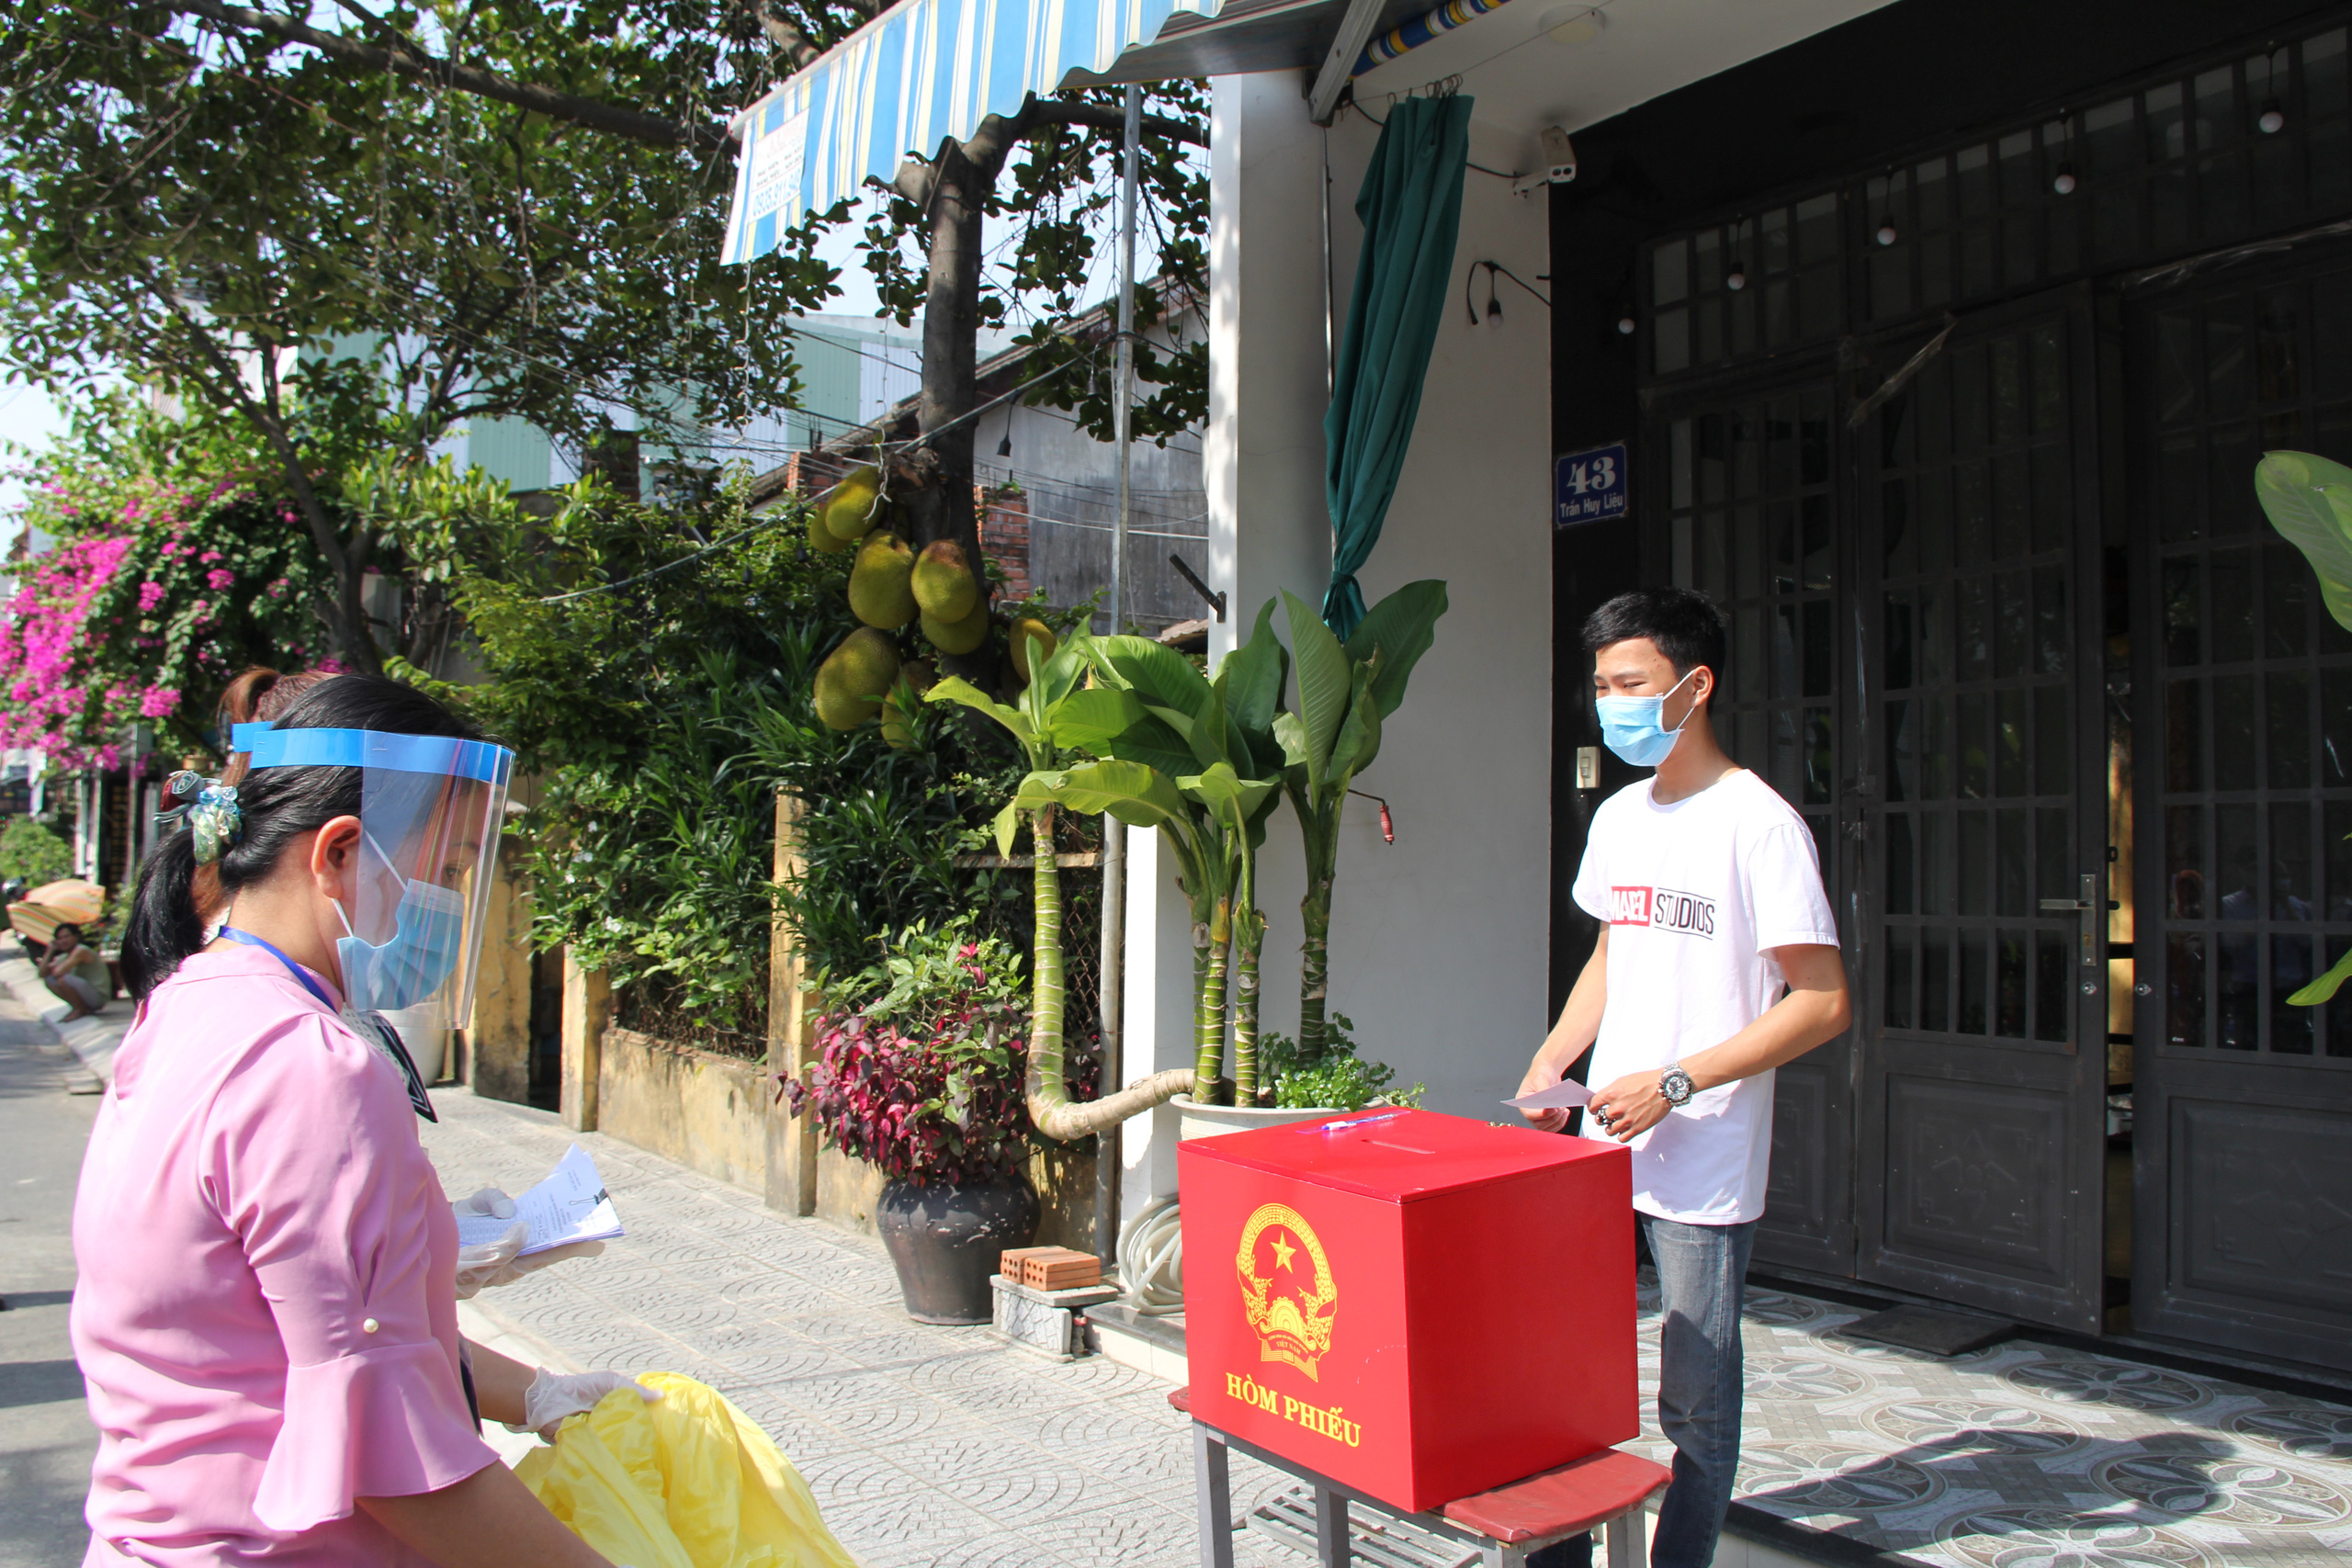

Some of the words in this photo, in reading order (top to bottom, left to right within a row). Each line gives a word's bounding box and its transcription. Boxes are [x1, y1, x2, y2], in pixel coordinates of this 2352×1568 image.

[1566, 457, 1616, 495] 43
[1583, 498, 1600, 515] Huy
[1604, 492, 1623, 513] Liệu
[1655, 893, 1715, 935] STUDIOS
[1226, 1371, 1279, 1416] HÒM
[1283, 1395, 1362, 1448] PHIẾU
